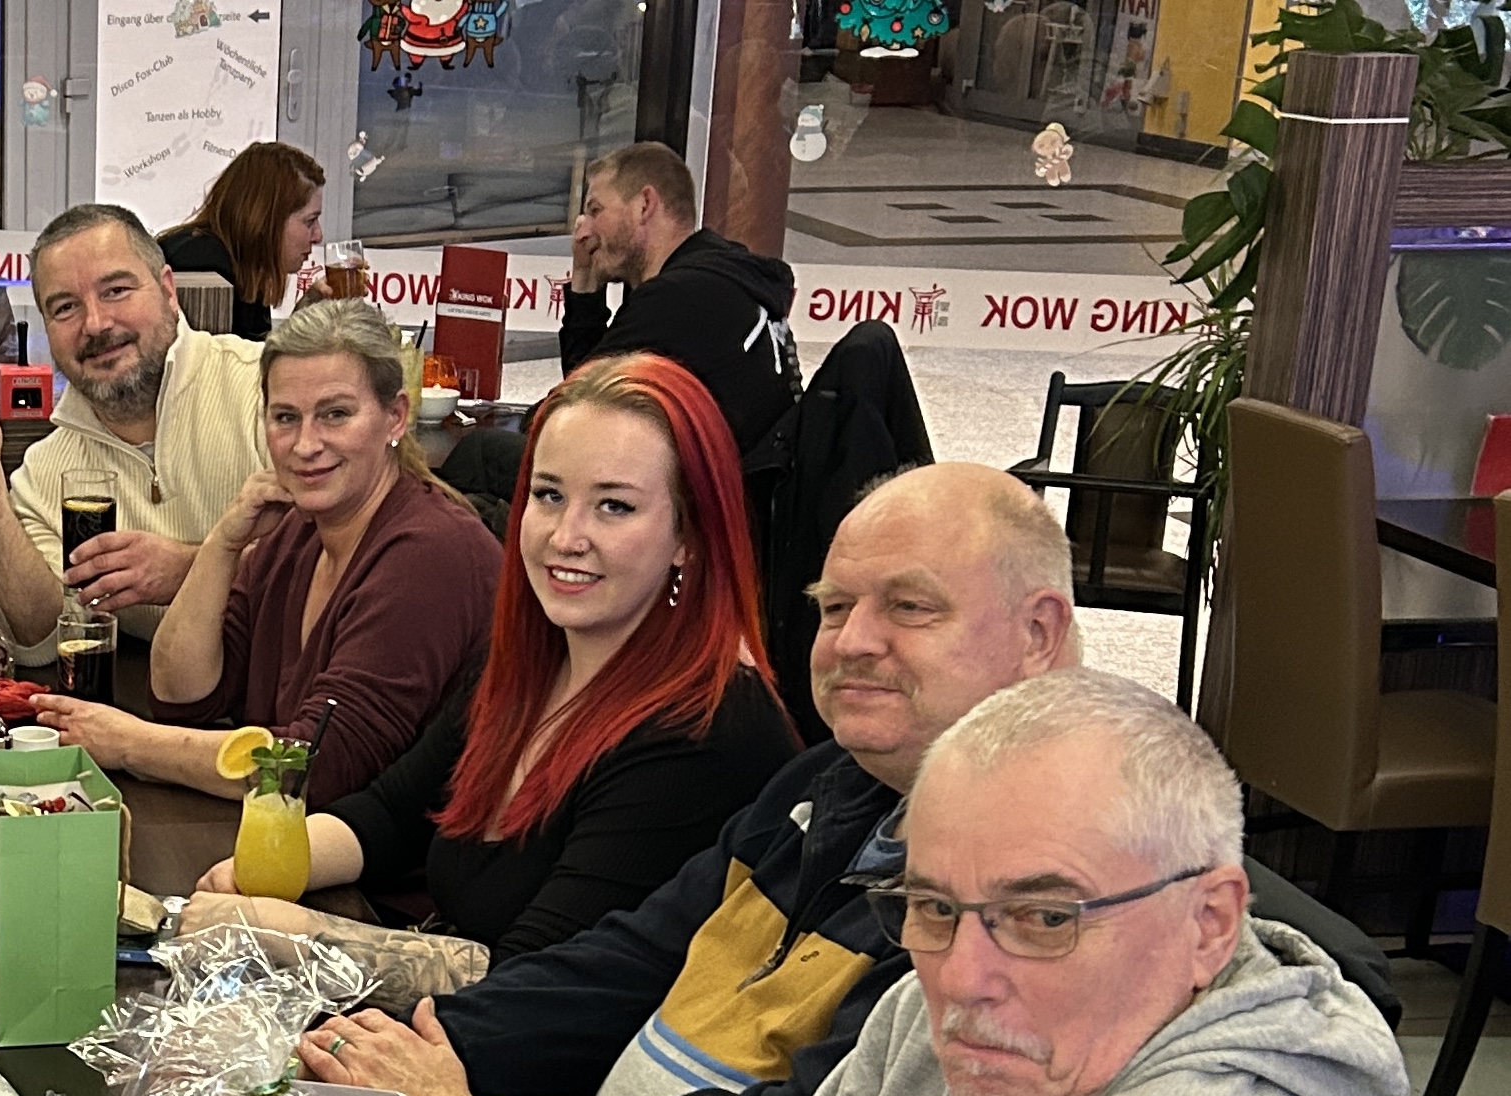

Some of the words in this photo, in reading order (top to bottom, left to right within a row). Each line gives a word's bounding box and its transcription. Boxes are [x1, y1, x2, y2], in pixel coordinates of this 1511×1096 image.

[107, 14, 141, 27] Eingang
[143, 13, 163, 24] über
[110, 78, 135, 97] Disco
[135, 54, 174, 82] Fox-Club
[219, 57, 256, 89] Tanzparty
[145, 111, 176, 122] Tanzen
[178, 109, 189, 121] als
[191, 108, 222, 121] Hobby
[123, 148, 172, 178] Workshops
